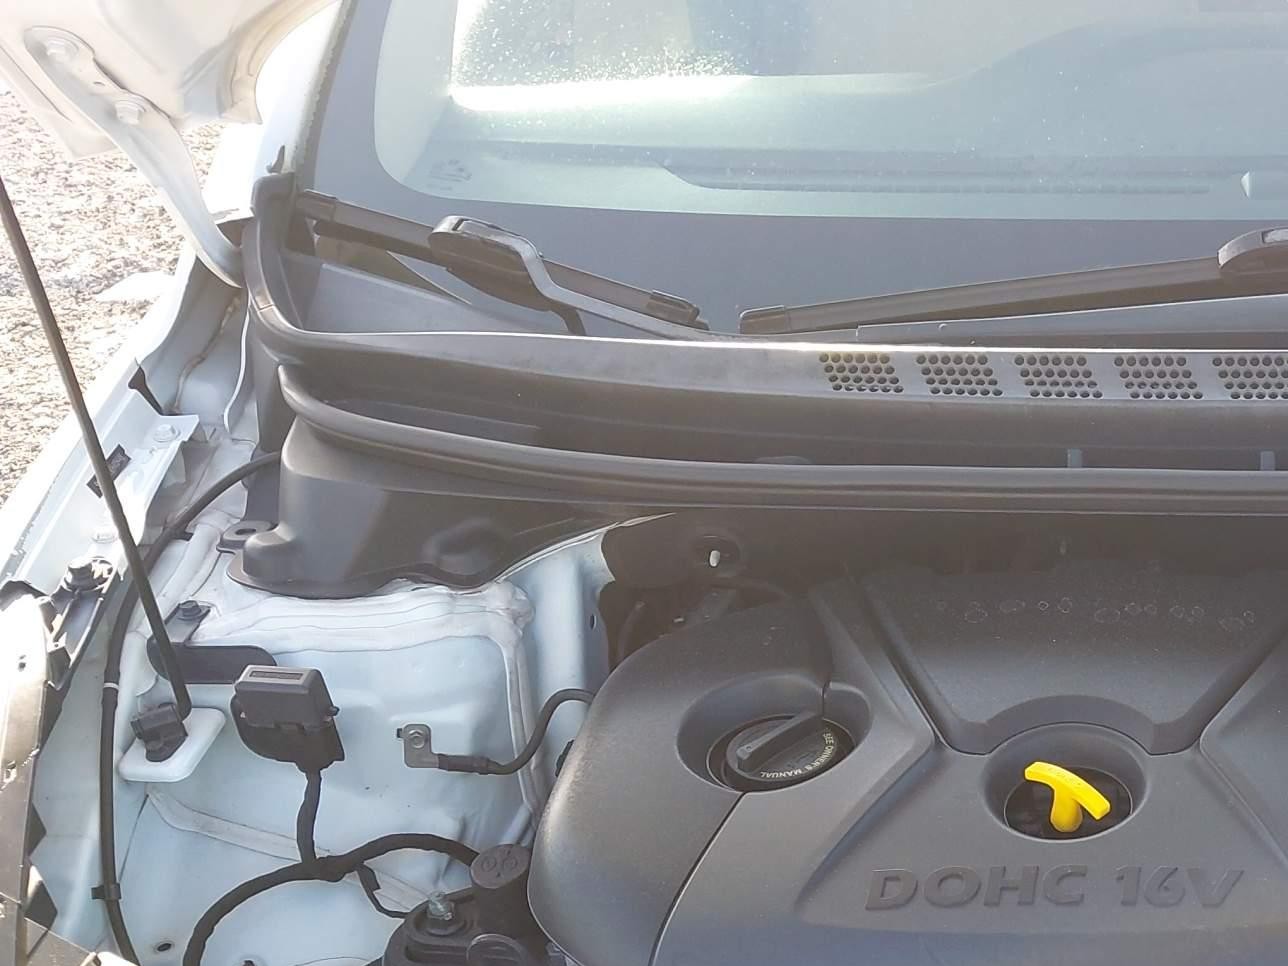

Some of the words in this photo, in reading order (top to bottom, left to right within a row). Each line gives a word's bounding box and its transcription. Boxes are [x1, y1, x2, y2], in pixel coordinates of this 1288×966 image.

[804, 746, 834, 770] OWNER'S
[759, 769, 802, 779] MANUAL
[865, 864, 1088, 910] DOHC
[1114, 864, 1244, 908] 16V
